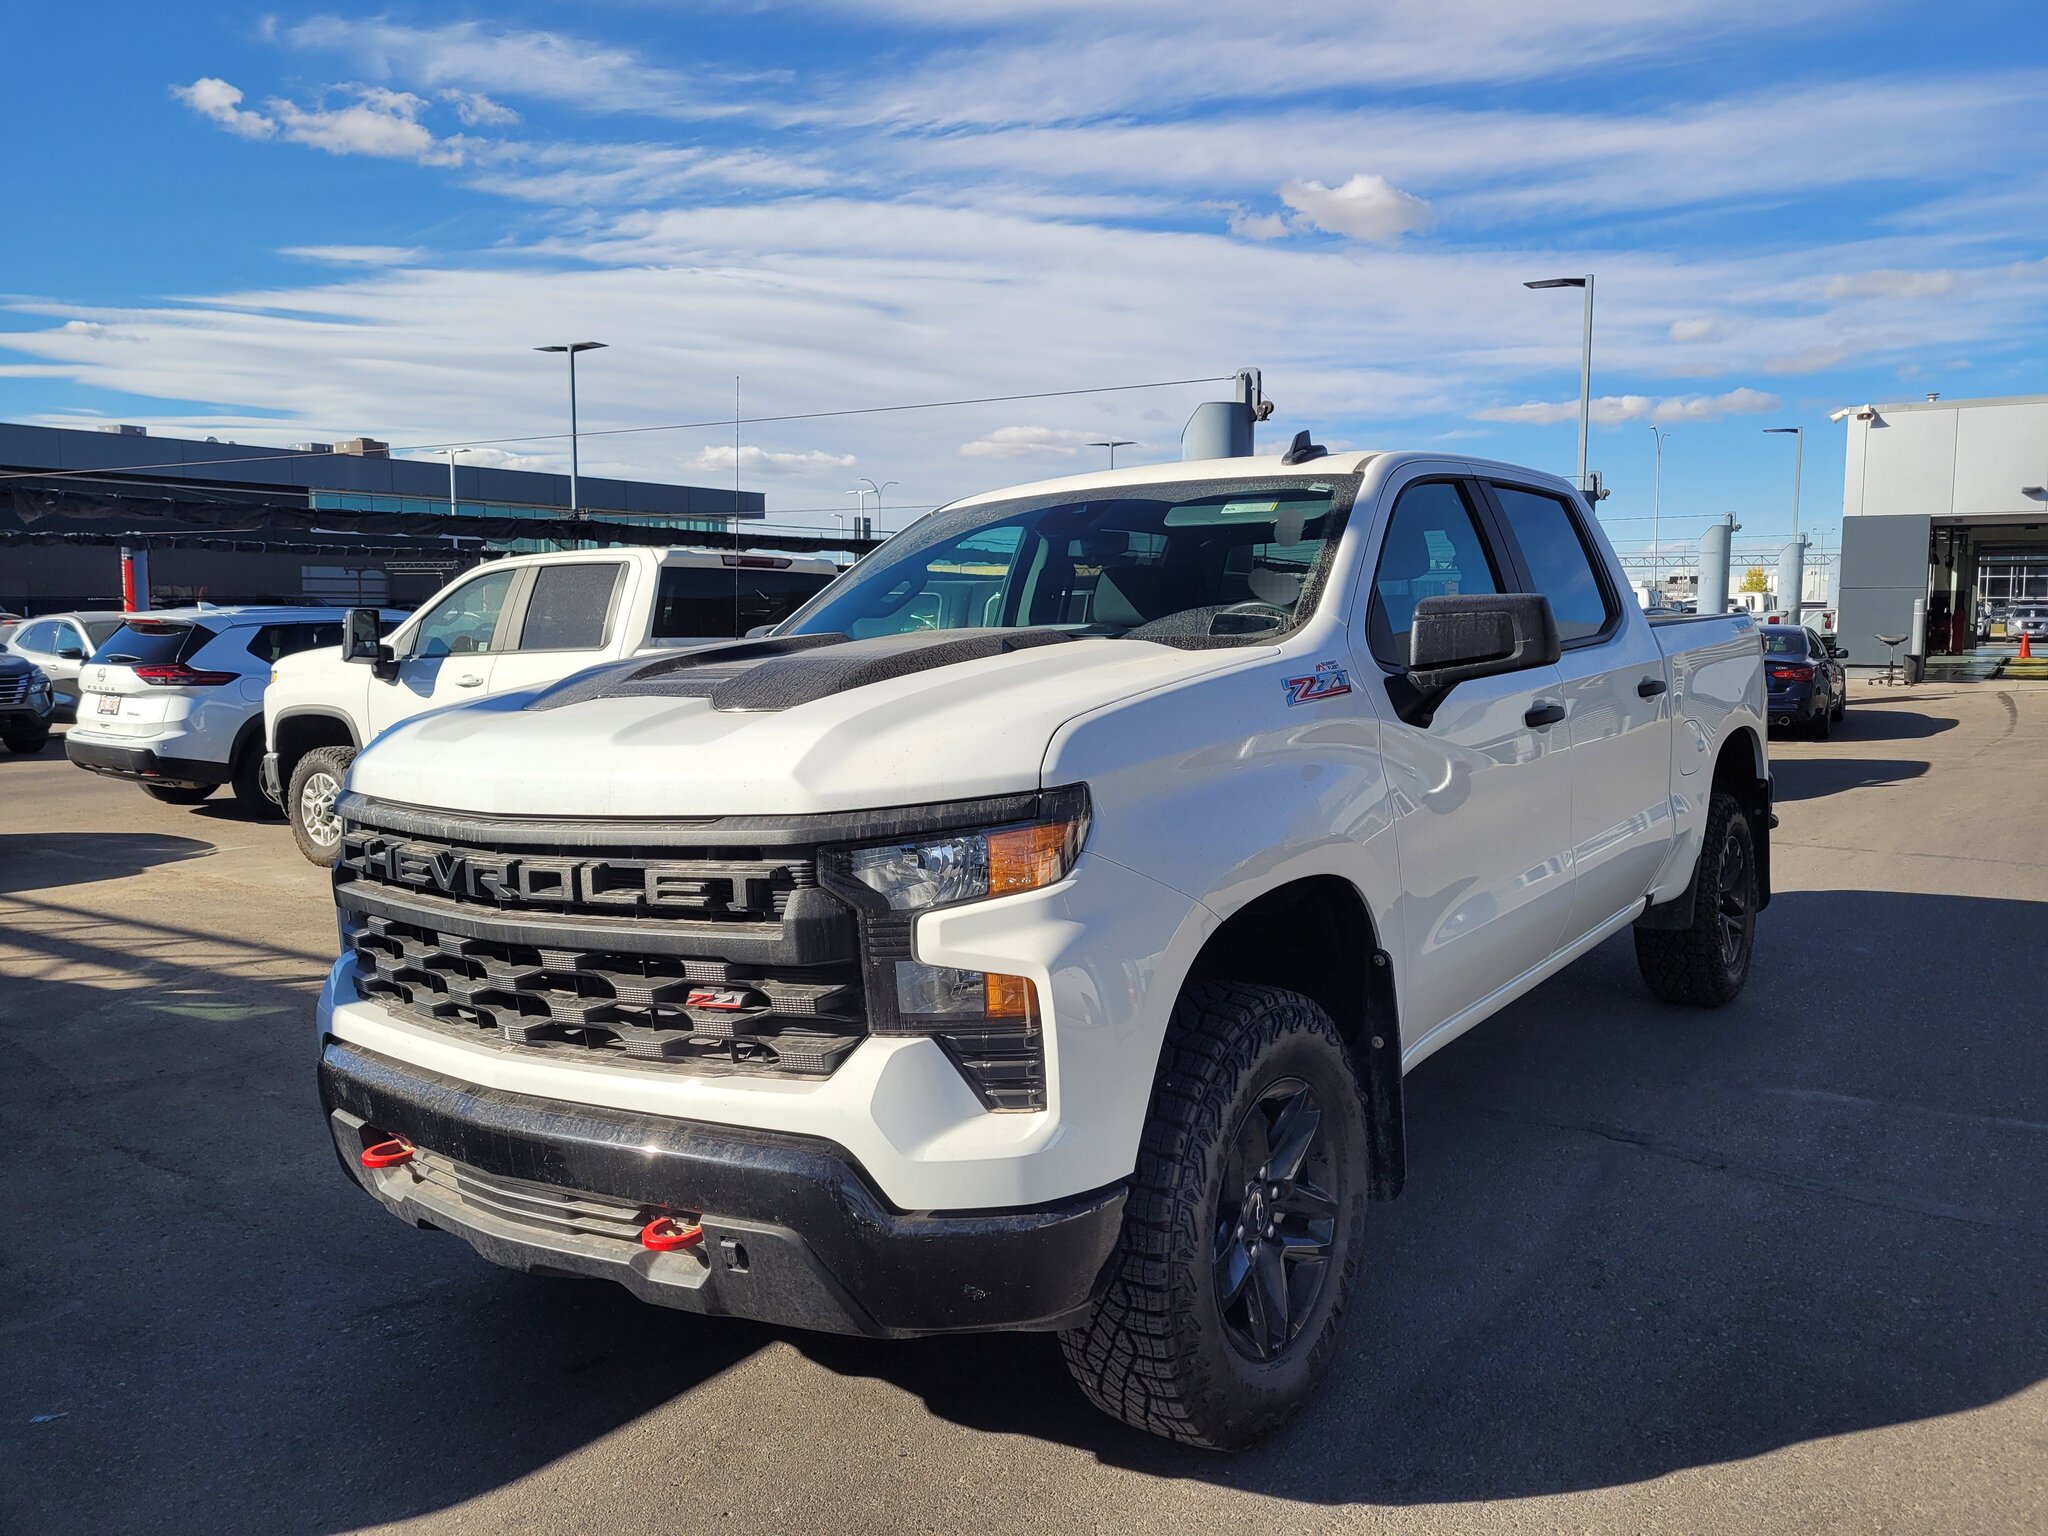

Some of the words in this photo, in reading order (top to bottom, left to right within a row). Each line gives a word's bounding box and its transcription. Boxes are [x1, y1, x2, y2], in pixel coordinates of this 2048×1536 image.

[1281, 670, 1352, 707] Z71
[341, 834, 787, 911] CHEVROLET
[686, 988, 746, 1009] Z71
